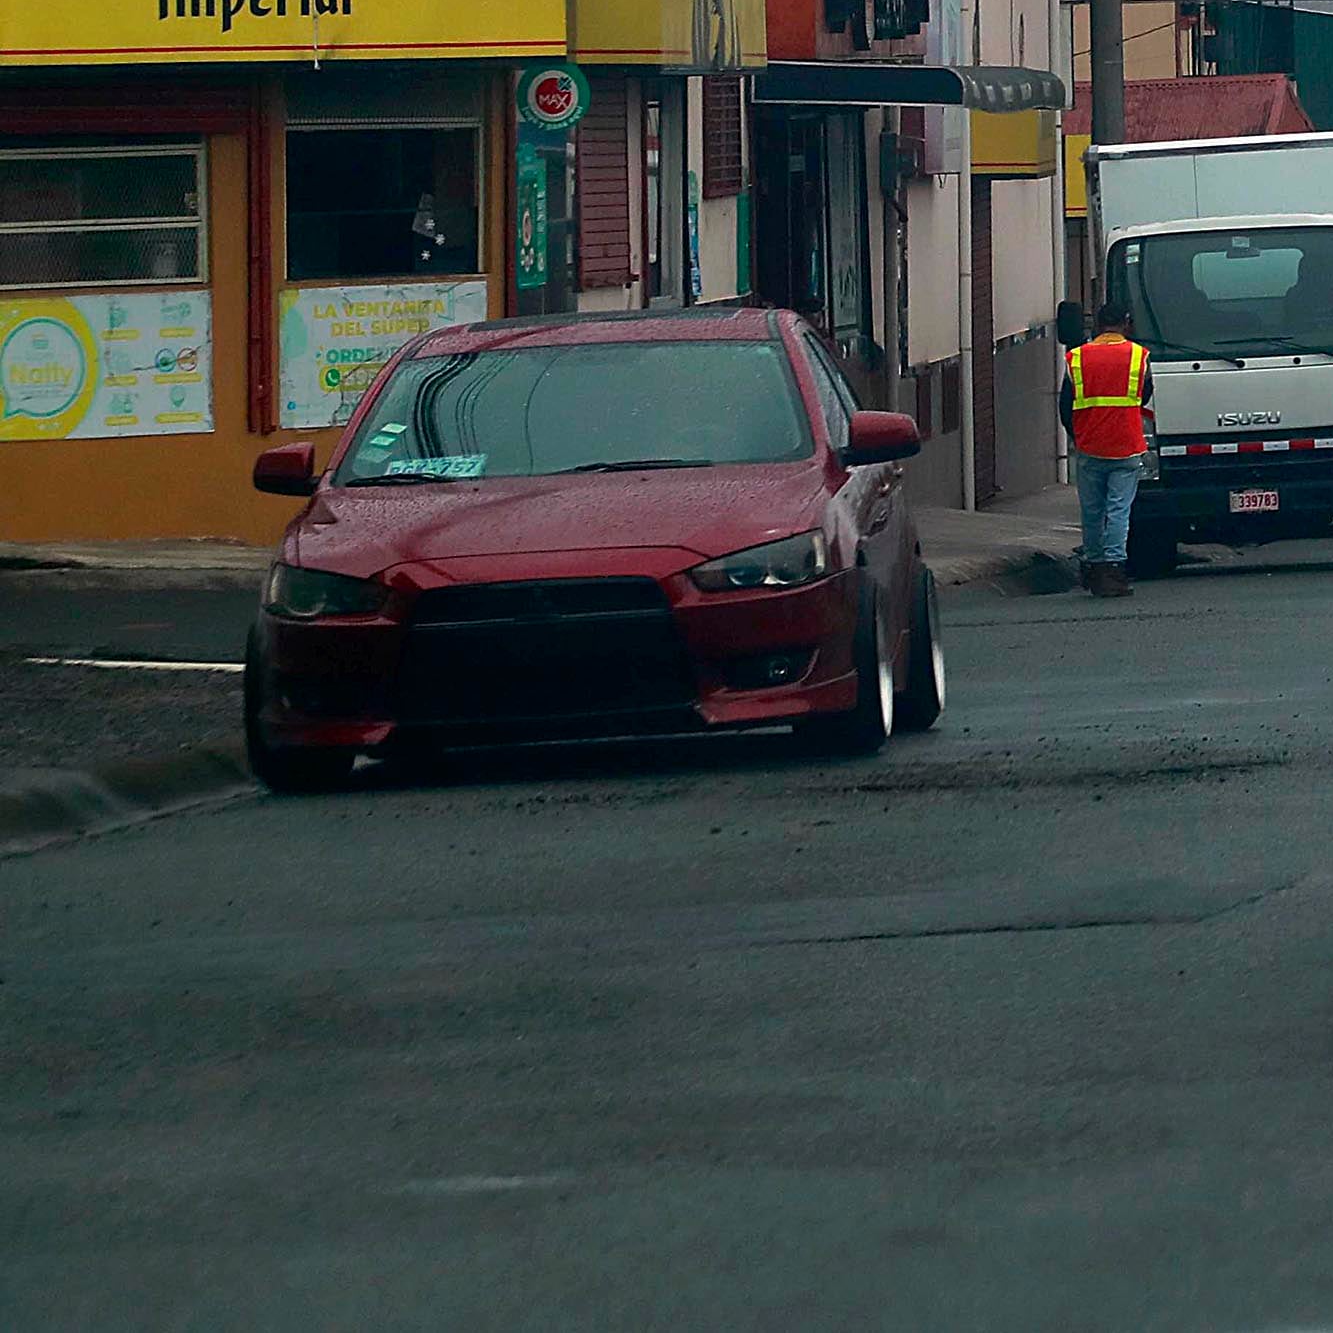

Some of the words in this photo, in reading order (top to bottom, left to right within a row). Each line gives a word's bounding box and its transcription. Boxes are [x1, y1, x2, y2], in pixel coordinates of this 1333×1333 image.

[539, 93, 569, 109] MAX
[314, 304, 338, 319] LA
[331, 322, 365, 337] DEL
[1217, 411, 1280, 427] ISUZU
